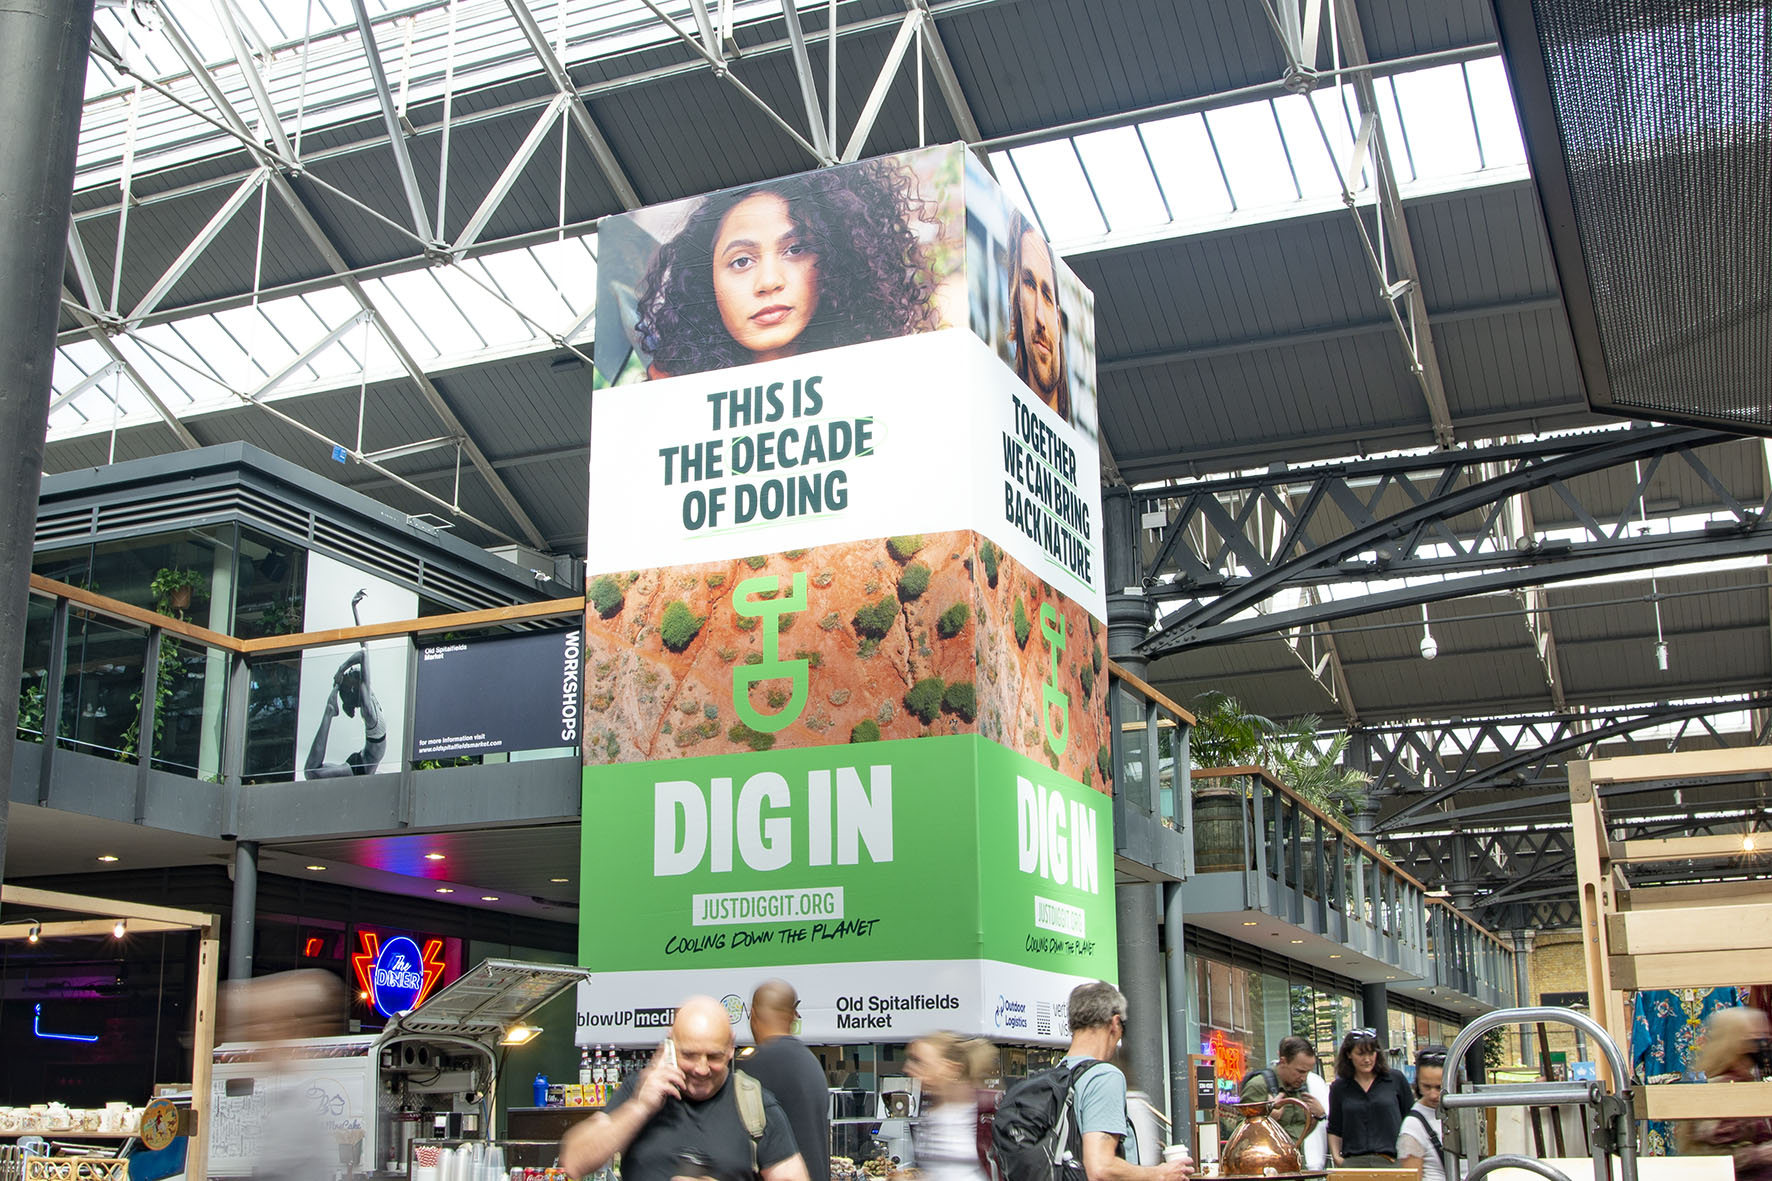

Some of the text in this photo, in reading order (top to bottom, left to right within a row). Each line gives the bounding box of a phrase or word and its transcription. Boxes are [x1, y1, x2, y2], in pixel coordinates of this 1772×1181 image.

[707, 376, 823, 431] THIS IS
[659, 416, 874, 486] THE DECADE
[1012, 394, 1078, 487] TOGETHER
[1002, 431, 1091, 540] WE CAN BRING
[682, 469, 848, 531] OF DOING
[1005, 480, 1092, 584] BACK NATURE
[424, 647, 435, 655] Old
[561, 630, 580, 741] WORKSHOPS
[474, 733, 486, 741] visit
[654, 765, 894, 877] DIG IN
[1017, 775, 1099, 895] DIG IN
[701, 892, 835, 920] JUSTDIGGIT.ORG
[665, 918, 880, 955] COOLING DOWN THE PLANET
[1025, 933, 1096, 956] COOLING DOWN THE PLANET
[392, 955, 411, 971] The
[376, 968, 421, 989] DINER
[577, 1009, 675, 1027] blowUP medi
[836, 994, 960, 1014] Old Spitalfields
[1005, 1000, 1026, 1013] Outdoor
[836, 1014, 892, 1028] Market
[1005, 1014, 1027, 1029] Logistics
